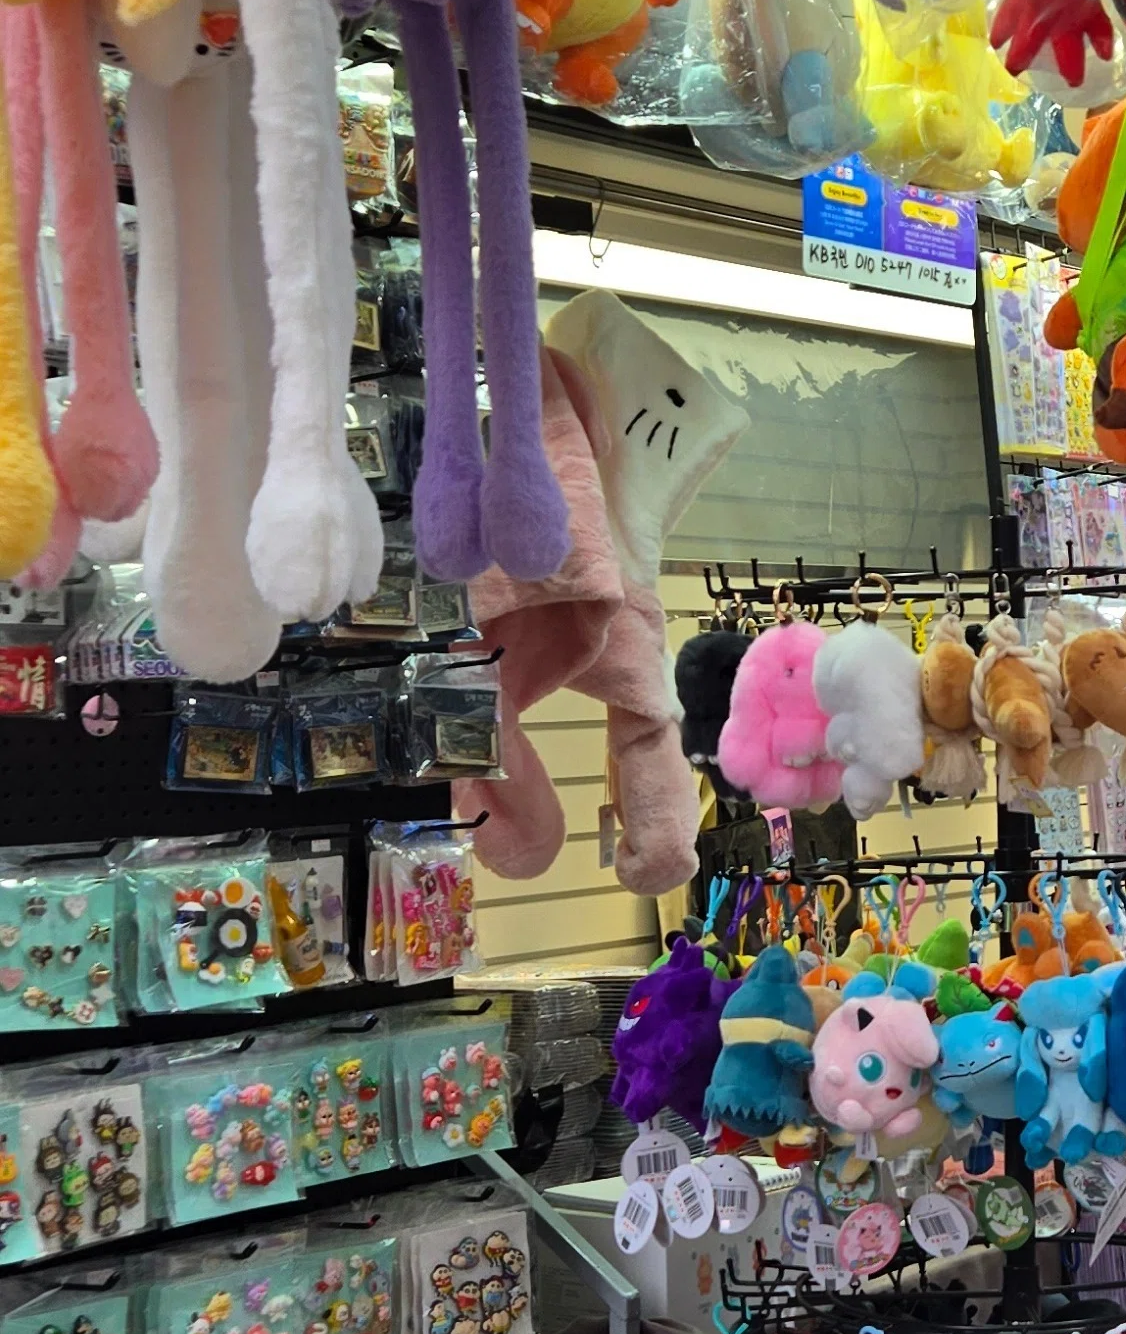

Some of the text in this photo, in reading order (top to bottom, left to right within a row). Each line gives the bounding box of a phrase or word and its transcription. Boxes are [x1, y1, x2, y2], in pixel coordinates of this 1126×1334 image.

[809, 243, 849, 269] KB국민
[855, 252, 875, 273] 010
[881, 258, 912, 280] 5247
